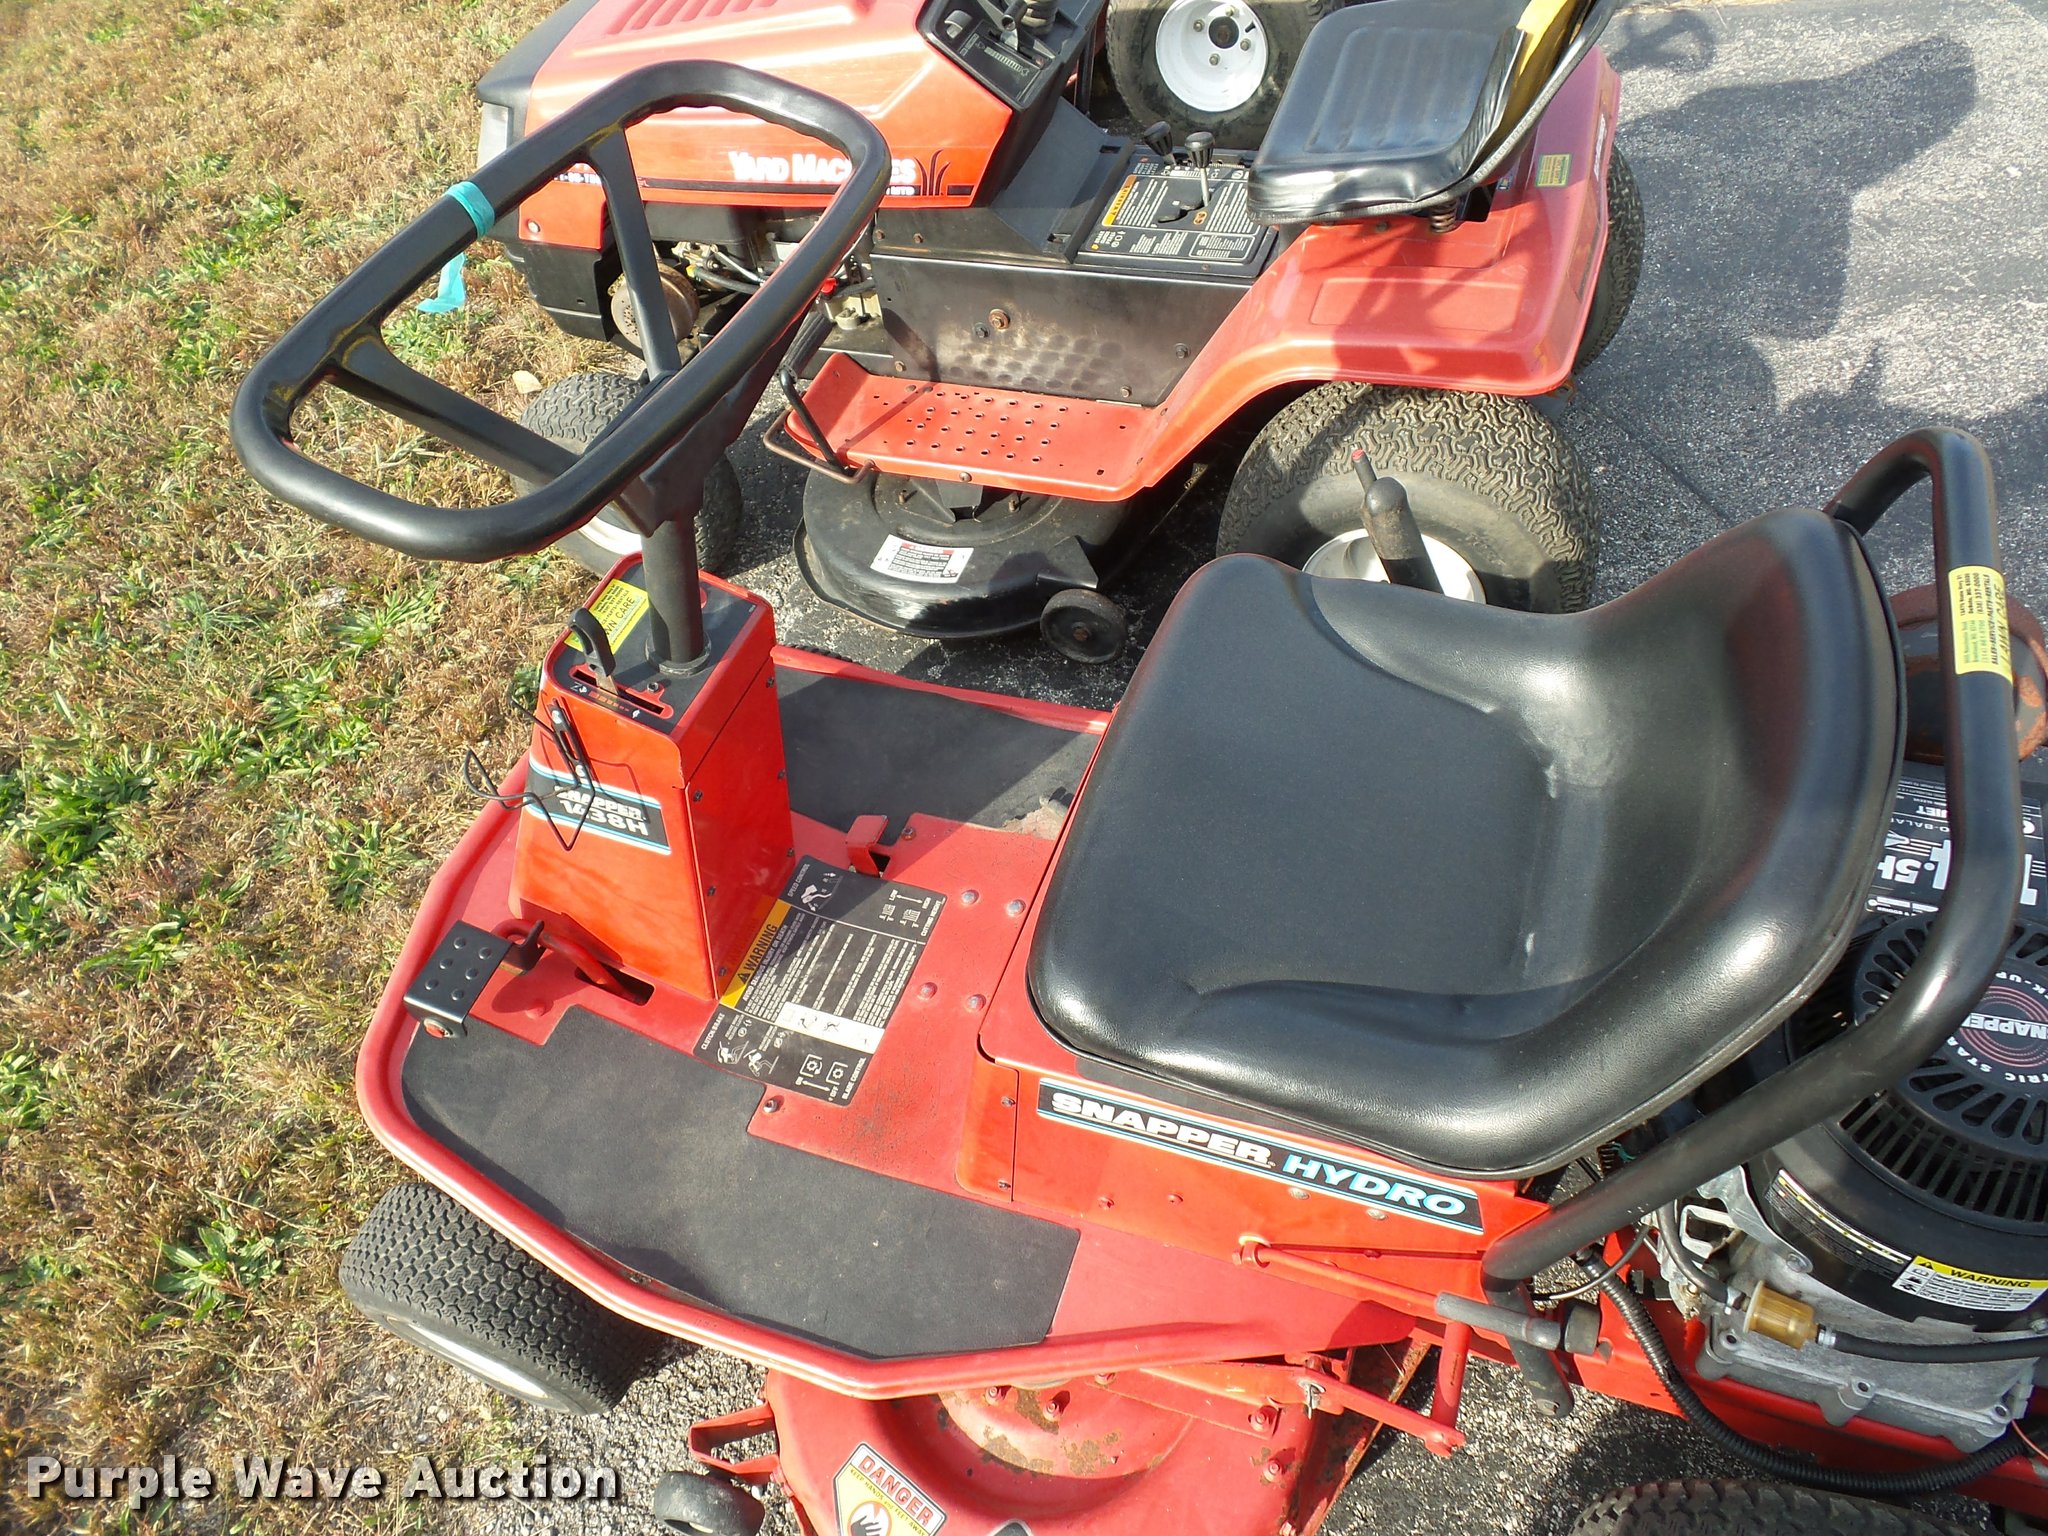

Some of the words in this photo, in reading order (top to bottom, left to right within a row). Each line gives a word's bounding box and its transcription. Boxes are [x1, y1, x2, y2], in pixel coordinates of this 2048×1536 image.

[728, 151, 789, 181] YARD
[792, 154, 916, 184] MACES
[744, 923, 777, 972] WARNING
[1946, 1036, 1993, 1073] STAR
[842, 1081, 855, 1099] BLADE
[850, 1057, 866, 1082] CONTROL
[1052, 1092, 1272, 1167] SNAPPER
[1283, 1154, 1466, 1216] HYDRO
[1950, 1269, 2031, 1288] WARNING
[850, 1468, 865, 1481] KEEP
[864, 1481, 885, 1501] HANDS
[894, 1508, 909, 1522] FEET
[858, 1455, 934, 1526] DANGER
